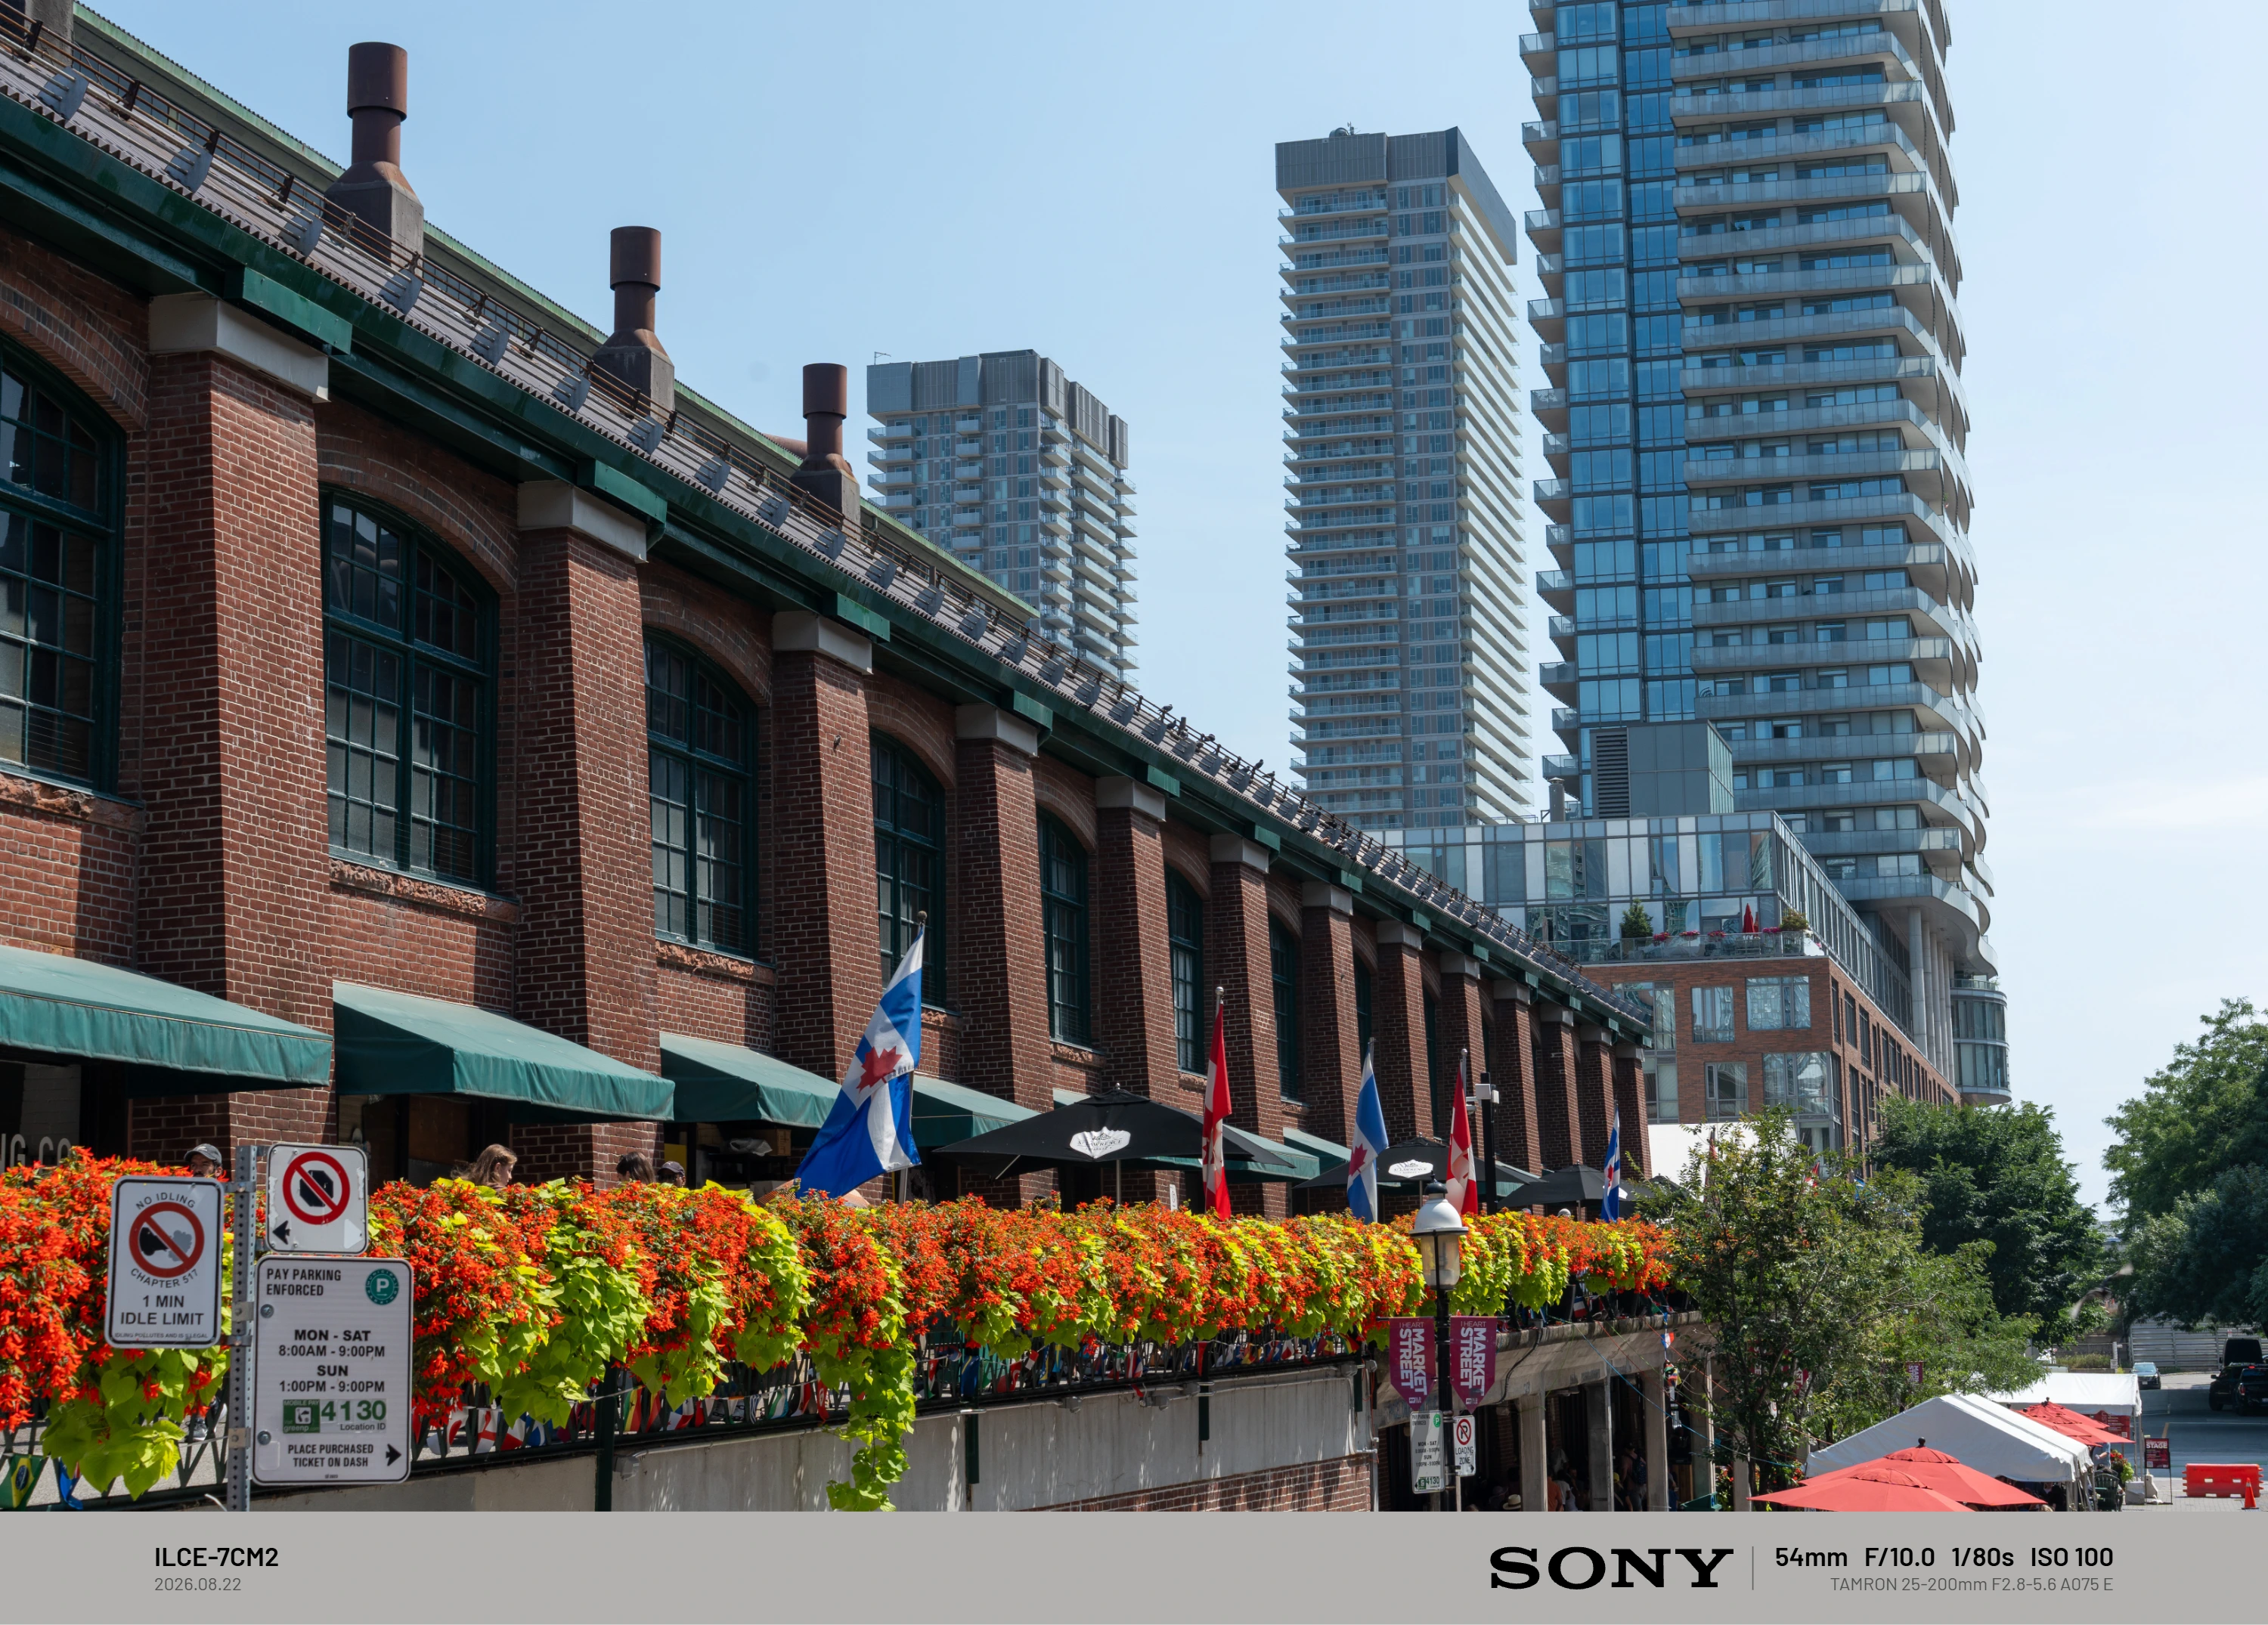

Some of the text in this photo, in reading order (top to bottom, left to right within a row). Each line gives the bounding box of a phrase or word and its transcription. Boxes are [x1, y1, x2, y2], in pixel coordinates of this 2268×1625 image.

[136, 1192, 196, 1209] NO IDLING
[131, 1268, 198, 1288] CHAPTER 517
[267, 1268, 342, 1281] PAY PARKING
[267, 1284, 324, 1296] ENFORCED
[376, 1278, 389, 1292] P
[143, 1295, 184, 1308] 1 MIN
[121, 1312, 204, 1325] IDLE LIMIT
[294, 1329, 329, 1341] MON
[342, 1330, 371, 1342] SAT
[279, 1345, 327, 1357] 8:00AM
[339, 1345, 385, 1357] 9:00PM
[1461, 1327, 1473, 1388] STREET
[1399, 1328, 1414, 1389] STREET
[1412, 1328, 1427, 1395] MARKET
[1473, 1328, 1486, 1396] MARKET
[317, 1365, 349, 1376] SUN
[280, 1381, 326, 1392] 1:00PM
[338, 1381, 385, 1392] 9:00PM
[321, 1400, 386, 1421] 4130
[288, 1444, 373, 1454] PLACE PURCHASED
[293, 1457, 368, 1467] TICKET ON DASH
[1459, 1456, 1470, 1465] ZONE
[1426, 1476, 1440, 1484] 4130
